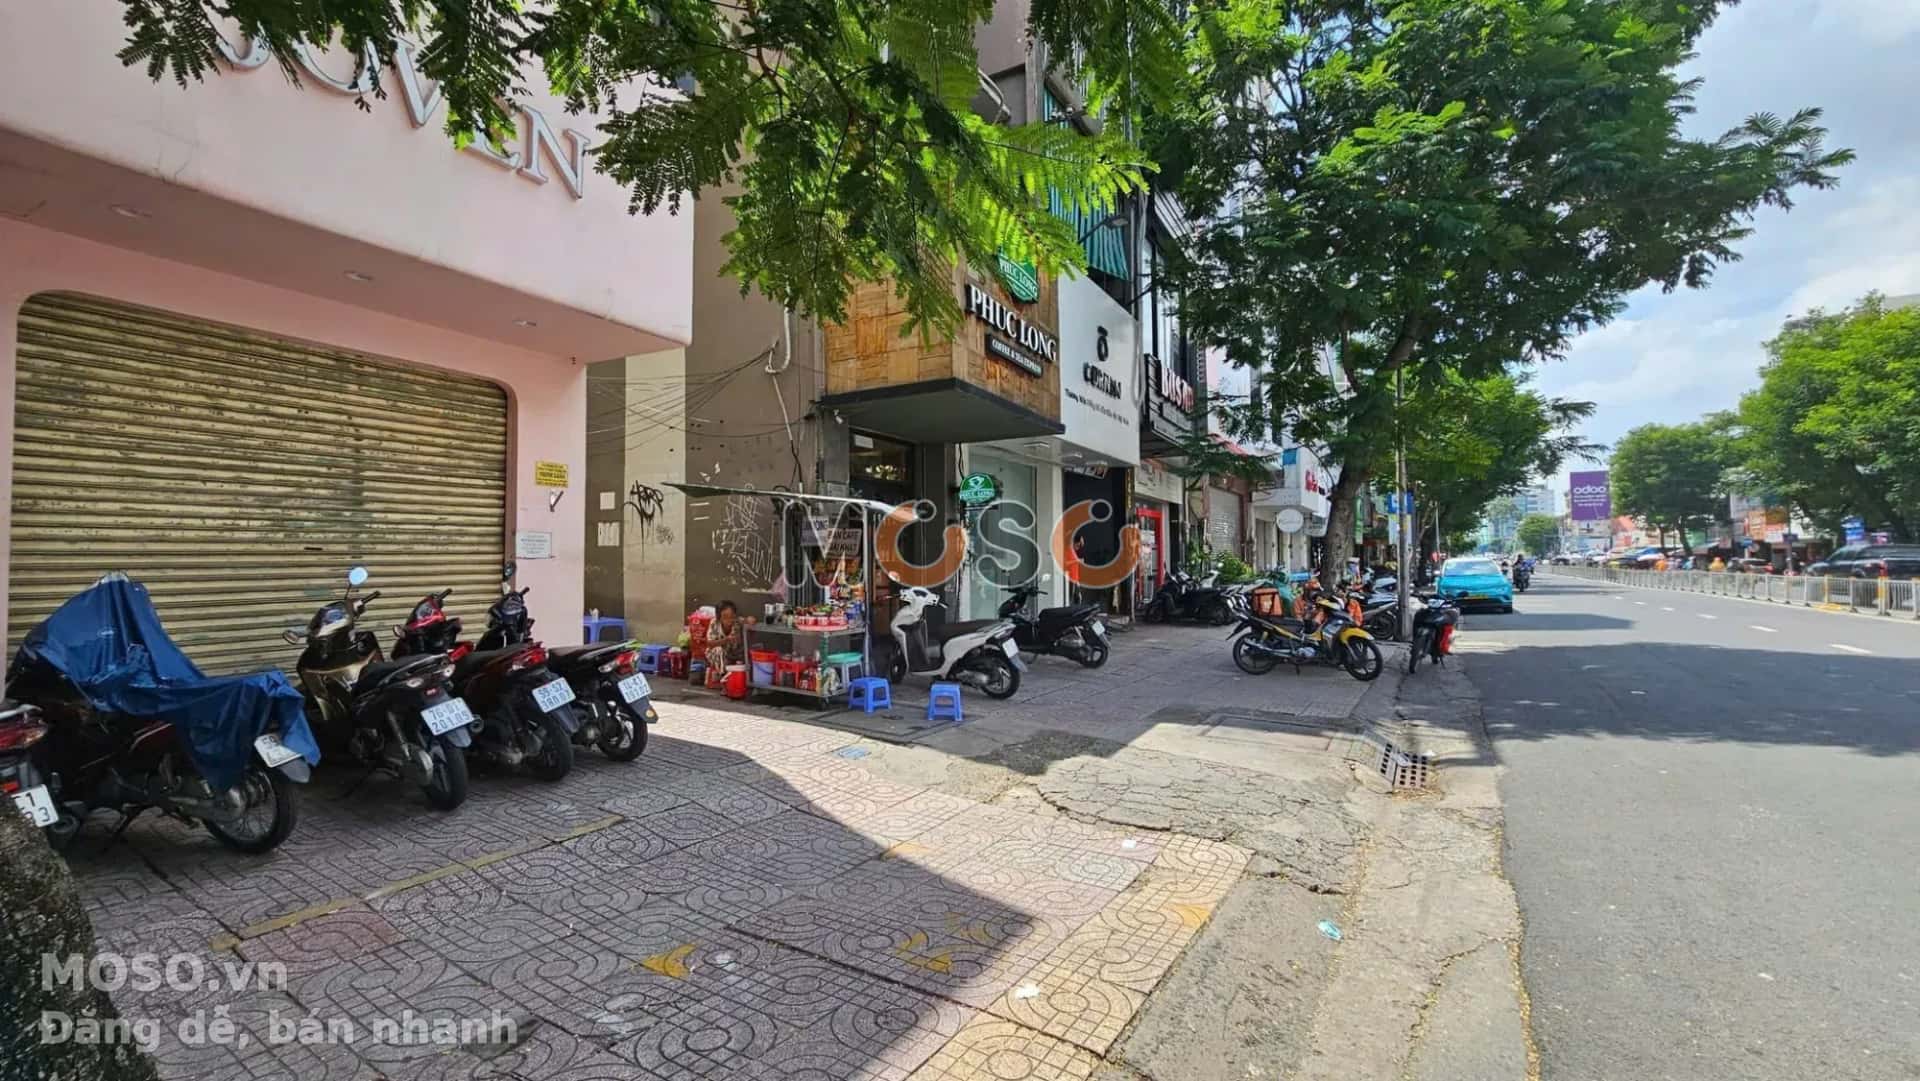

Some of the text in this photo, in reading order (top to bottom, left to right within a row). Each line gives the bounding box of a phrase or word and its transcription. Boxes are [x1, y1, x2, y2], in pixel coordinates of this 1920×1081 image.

[970, 284, 1057, 362] PHUC LONG
[1573, 485, 1607, 494] odoo
